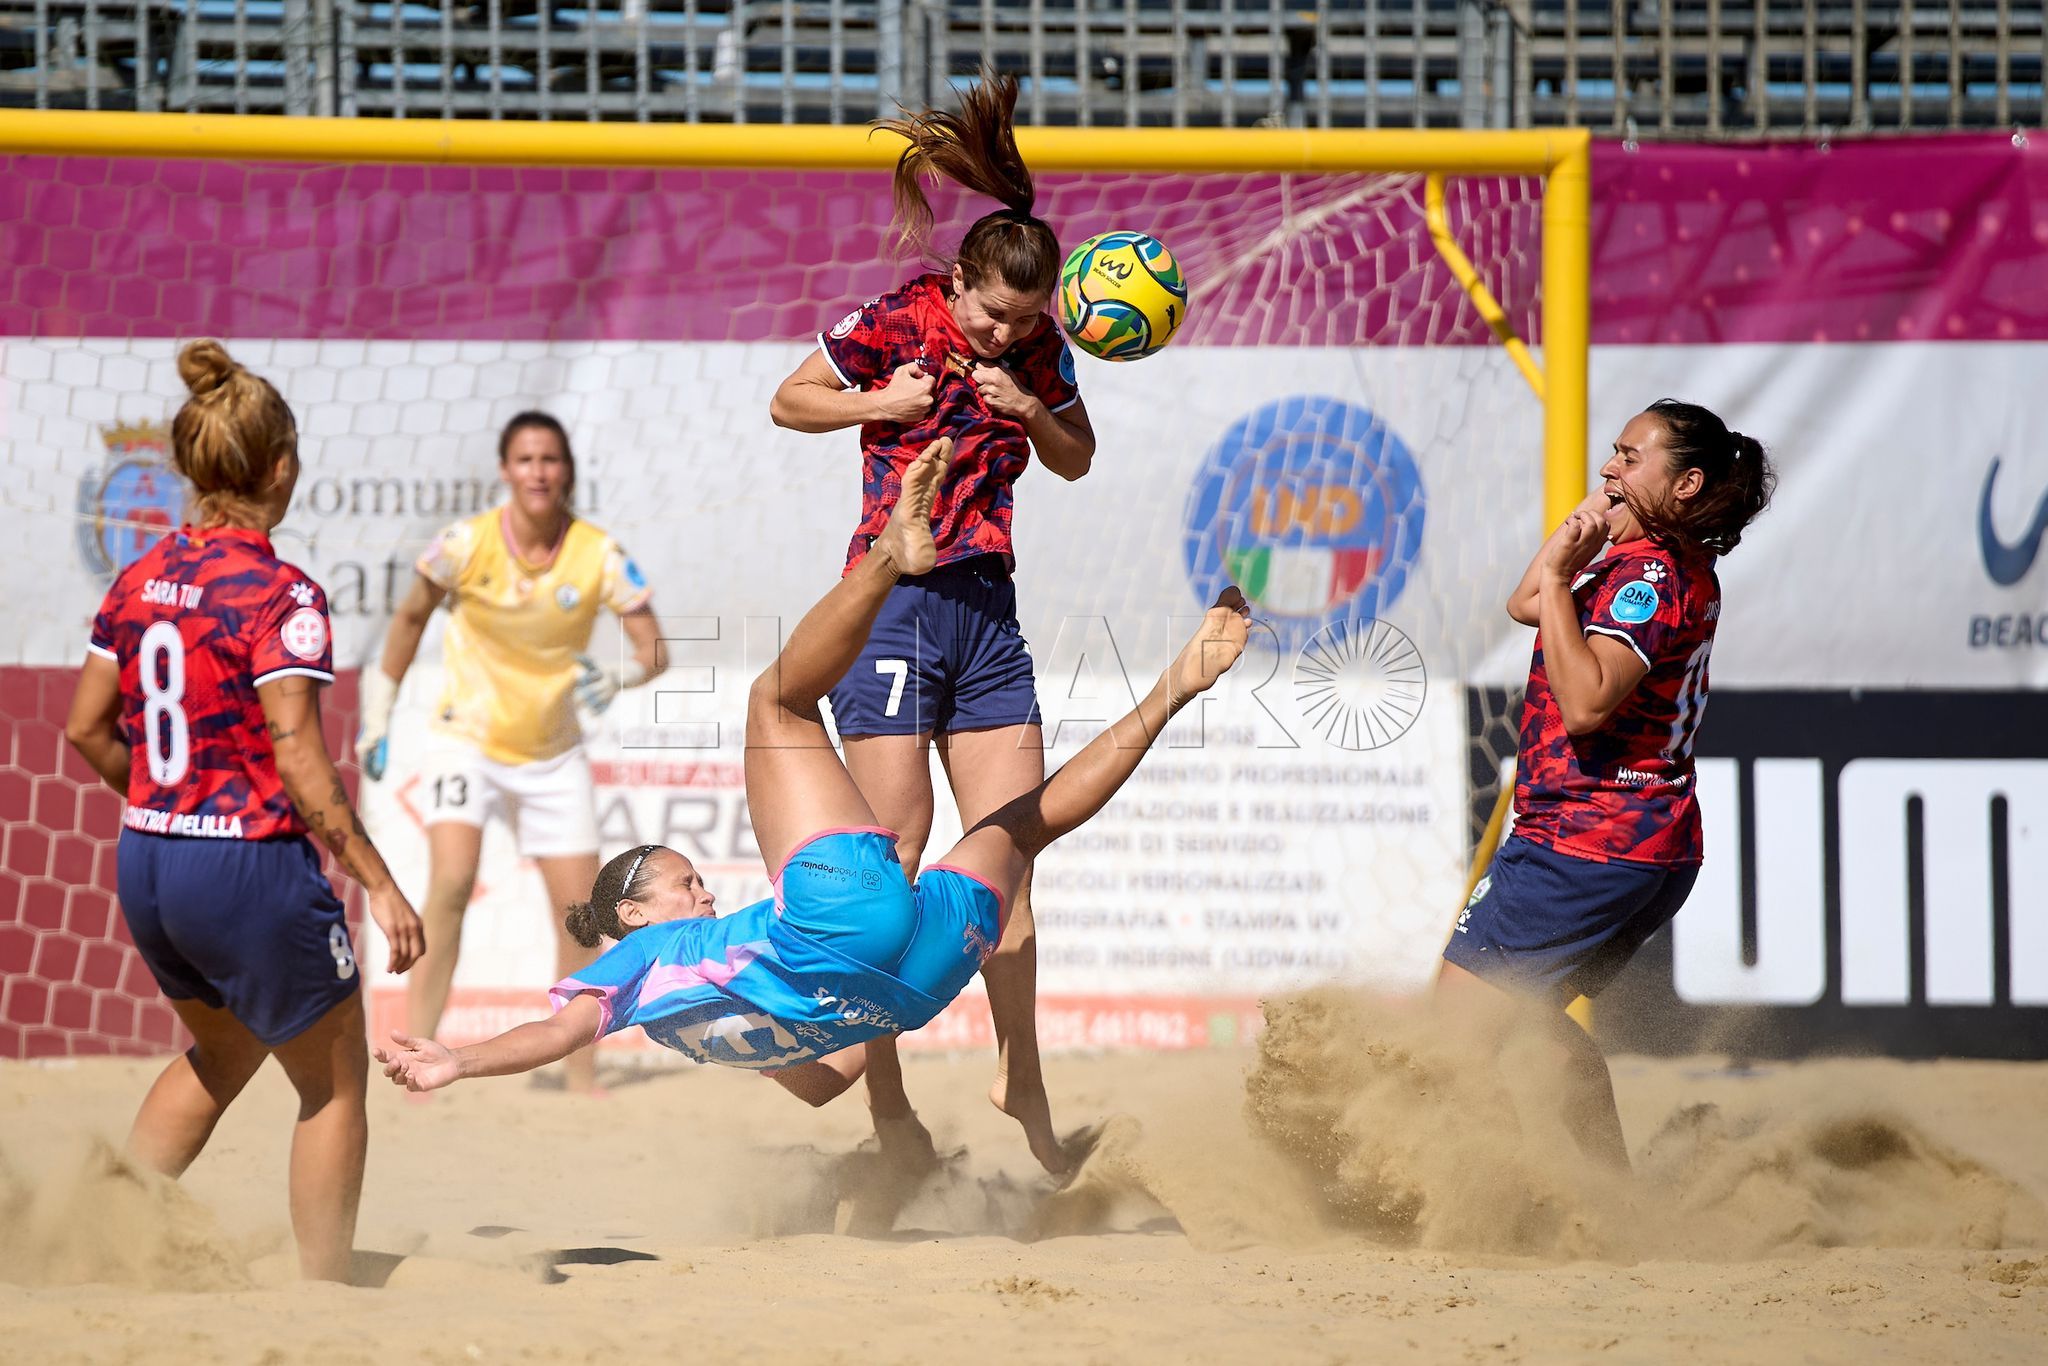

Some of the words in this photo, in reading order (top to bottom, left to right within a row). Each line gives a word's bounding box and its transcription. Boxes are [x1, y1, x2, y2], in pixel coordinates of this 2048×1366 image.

[1093, 267, 1106, 278] BEACH
[1106, 275, 1121, 289] SOCCER
[293, 477, 510, 516] omune
[141, 579, 178, 607] SARA
[1620, 596, 1650, 609] HUMANITY
[1624, 587, 1654, 606] ONE
[139, 619, 189, 786] 8
[875, 660, 908, 716] 7
[432, 774, 469, 808] 13
[169, 813, 244, 839] MELILLA
[329, 923, 355, 980] 8
